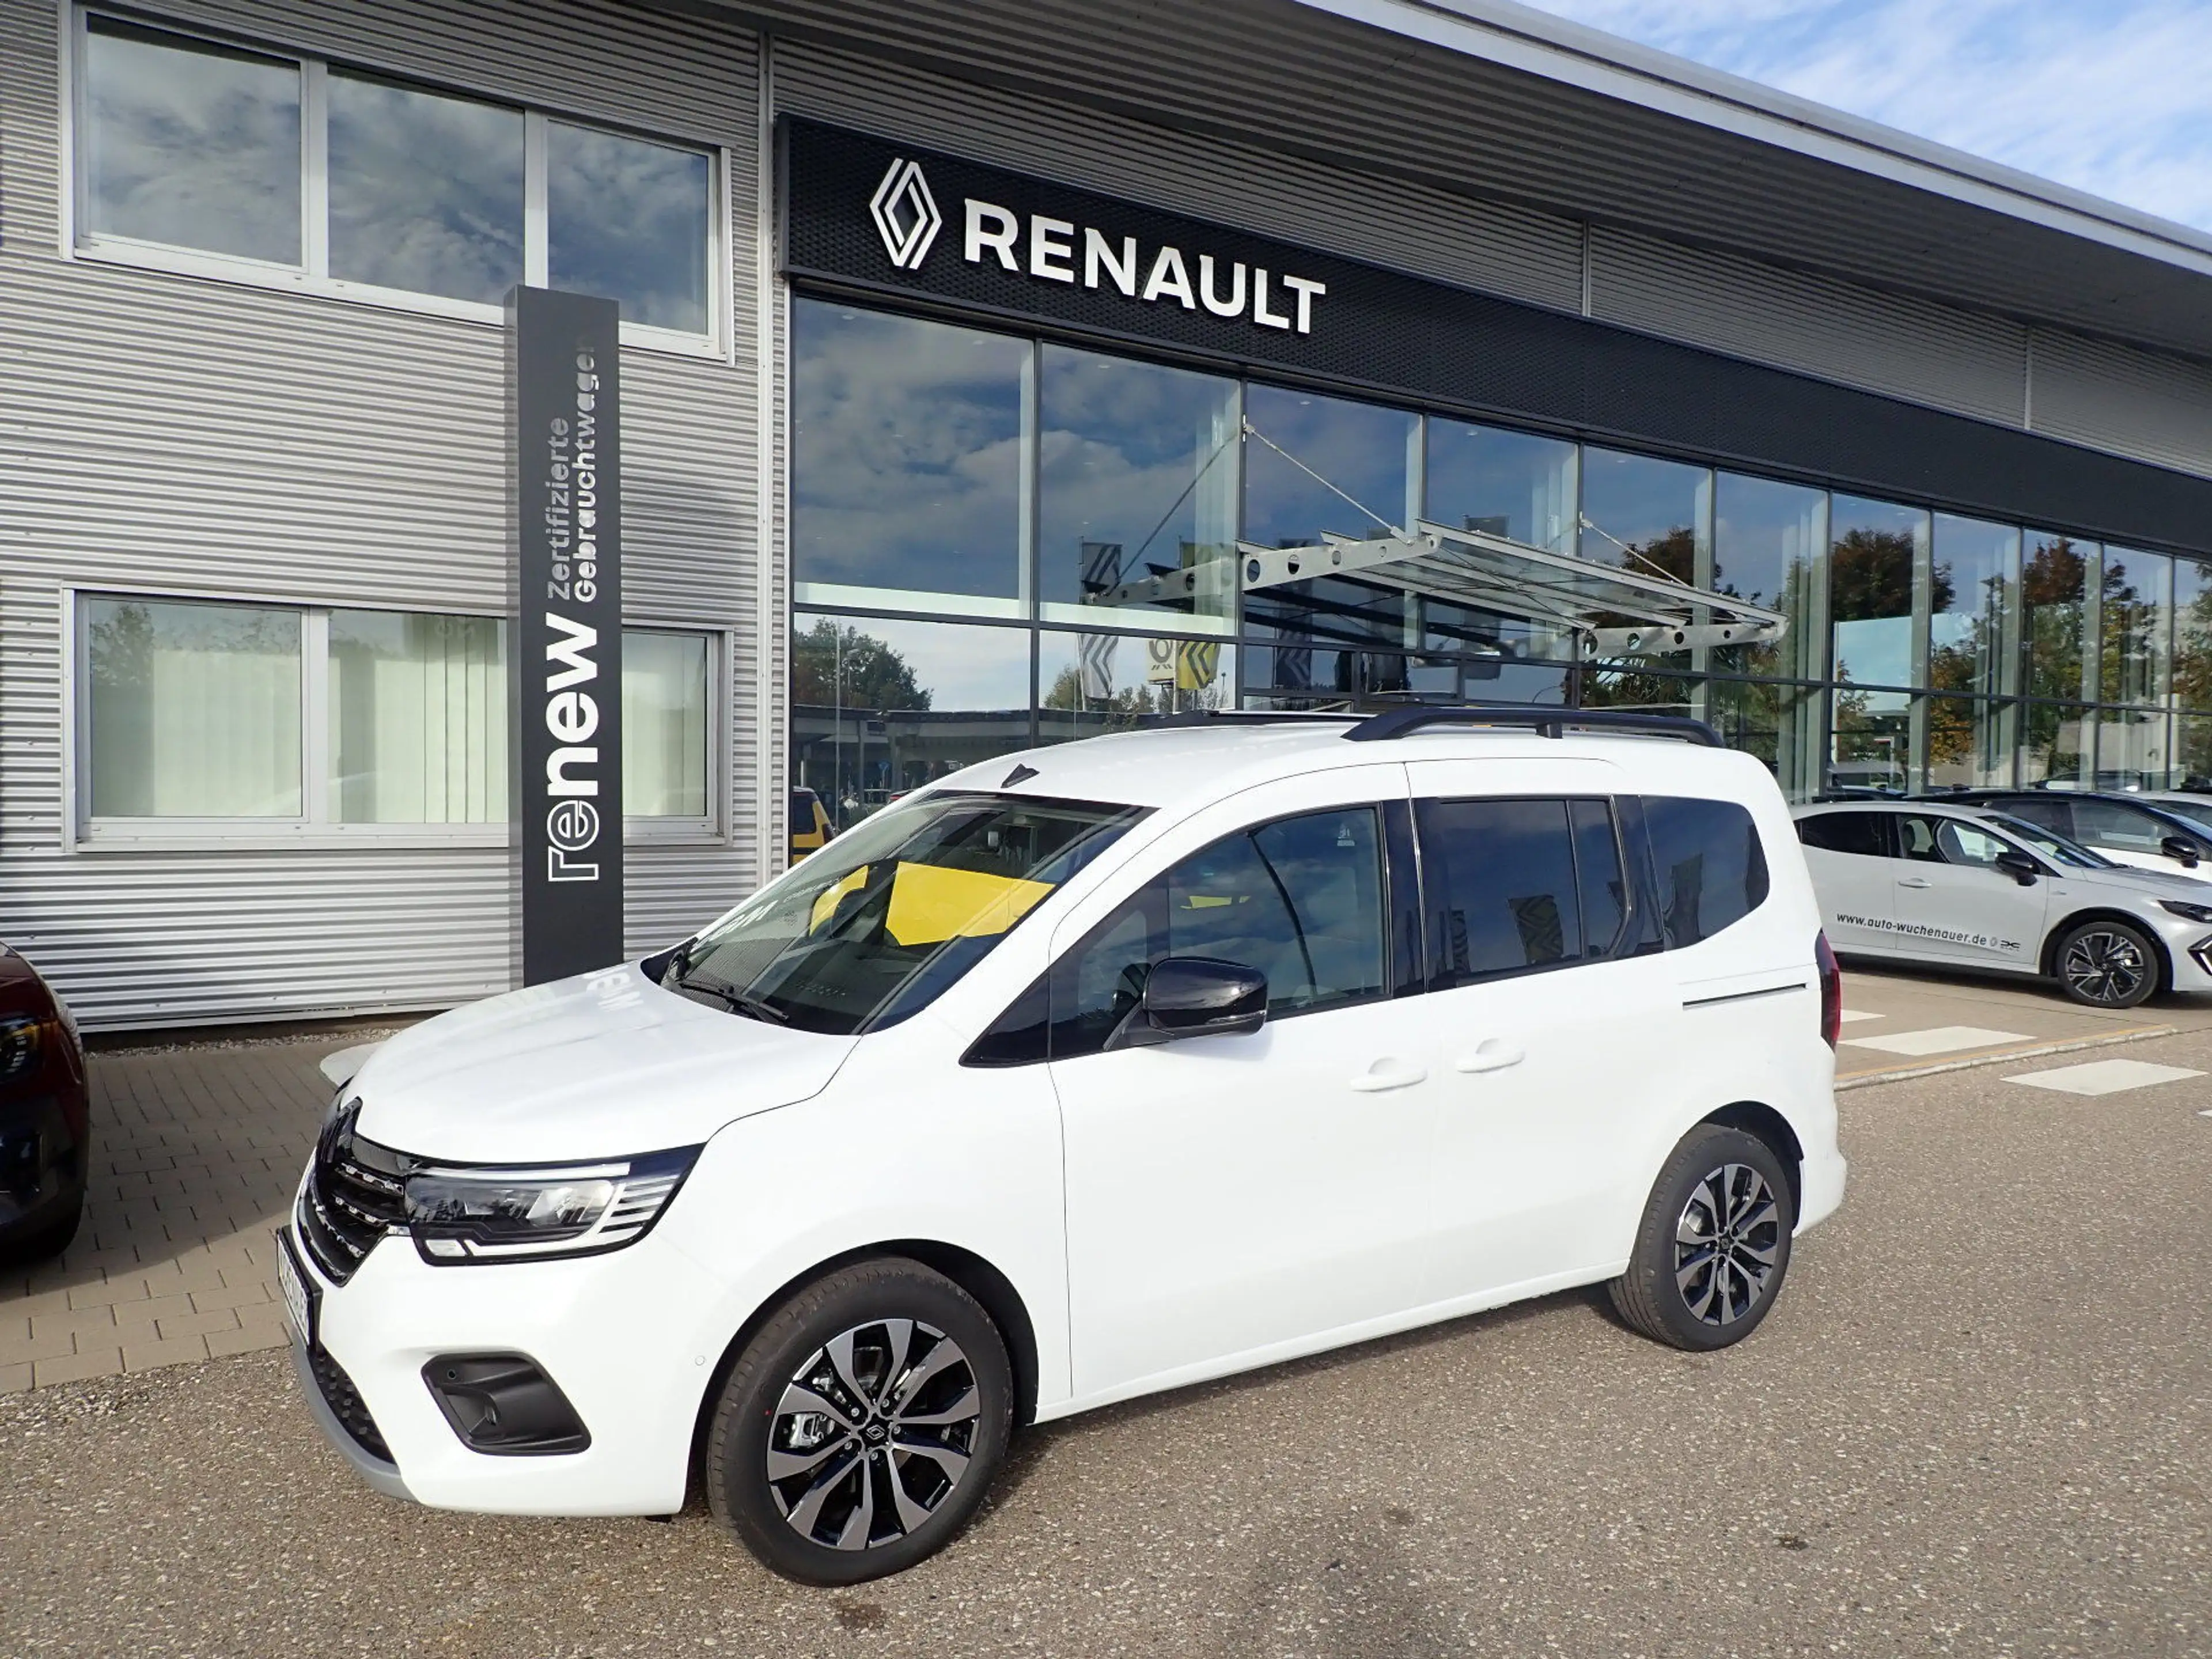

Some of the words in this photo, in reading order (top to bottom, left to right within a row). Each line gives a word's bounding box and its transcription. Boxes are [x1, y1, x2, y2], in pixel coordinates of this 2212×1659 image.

[964, 198, 1326, 334] RENAULT
[545, 417, 570, 601] Zertifizierte
[546, 612, 600, 882] renew
[1836, 913, 1987, 945] www.auto-wuchenauer.de
